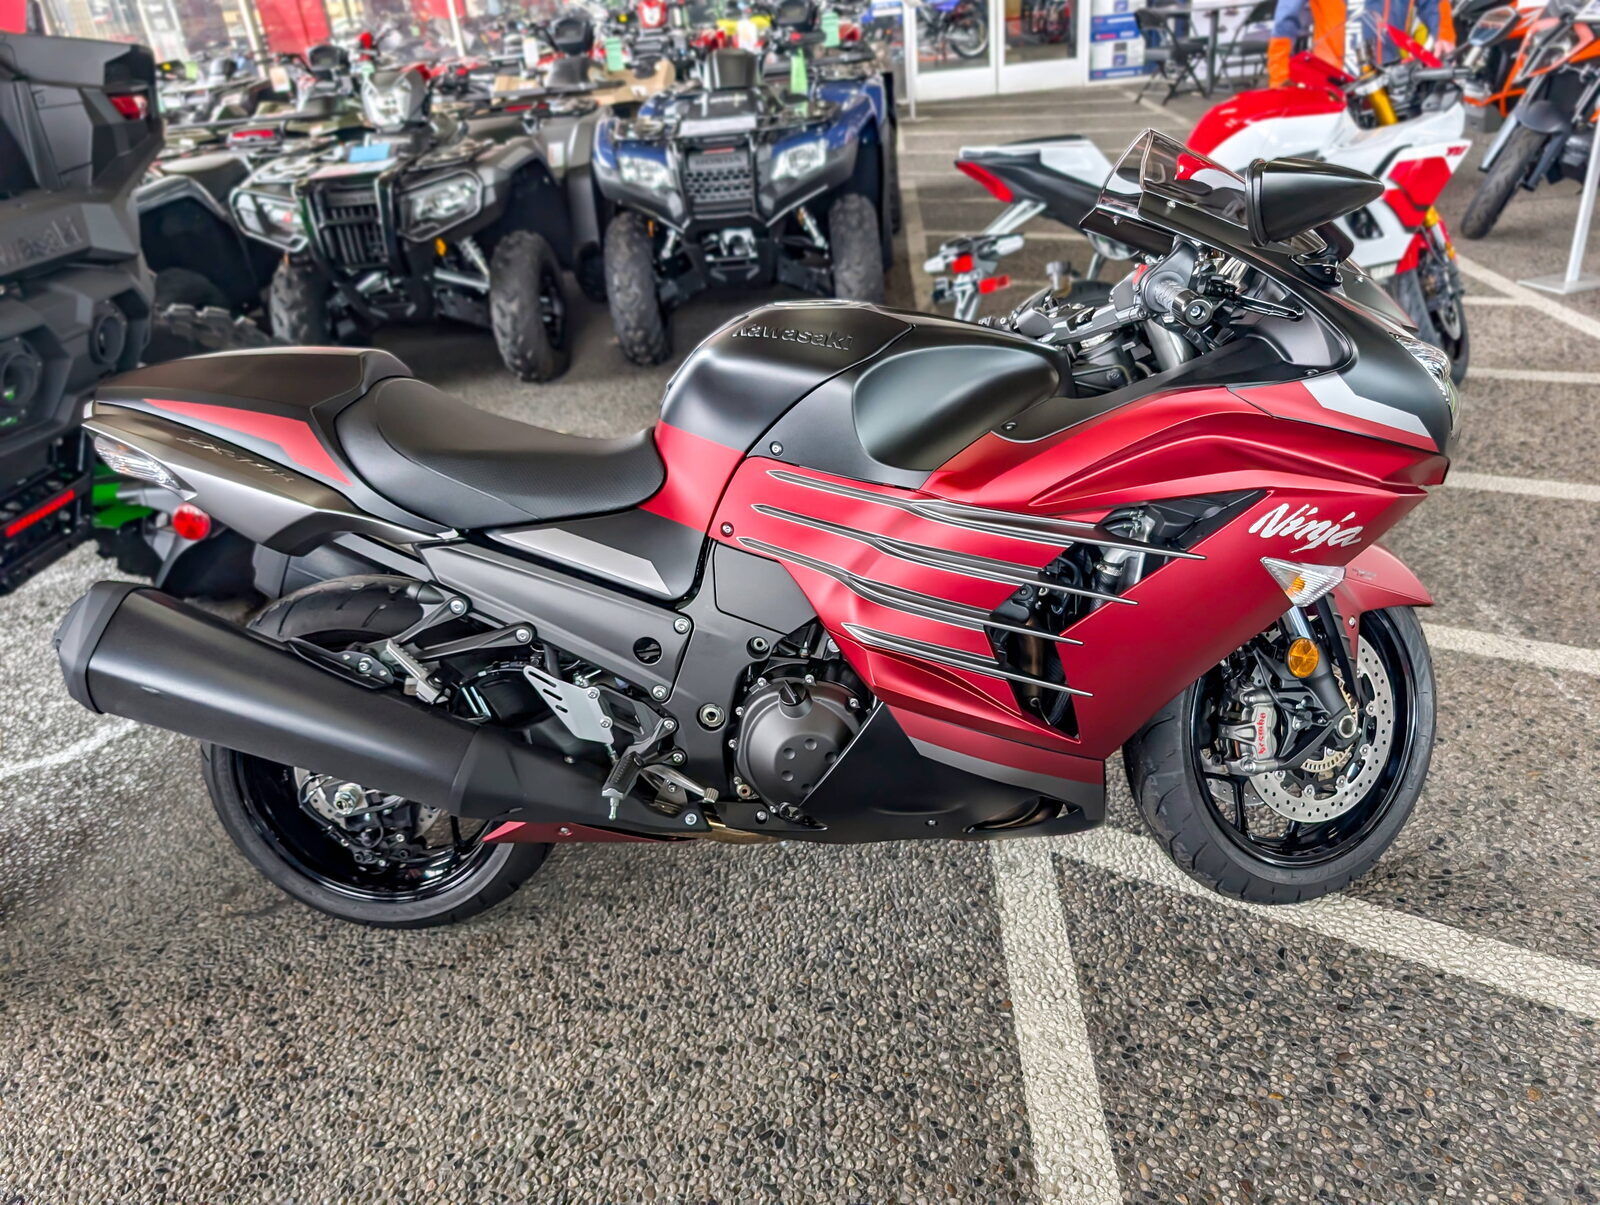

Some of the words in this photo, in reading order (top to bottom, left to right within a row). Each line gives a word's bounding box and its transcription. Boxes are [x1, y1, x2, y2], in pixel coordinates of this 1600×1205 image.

[732, 324, 853, 351] Kawasaki
[1248, 503, 1363, 553] Ninja
[1257, 712, 1266, 754] brembo
